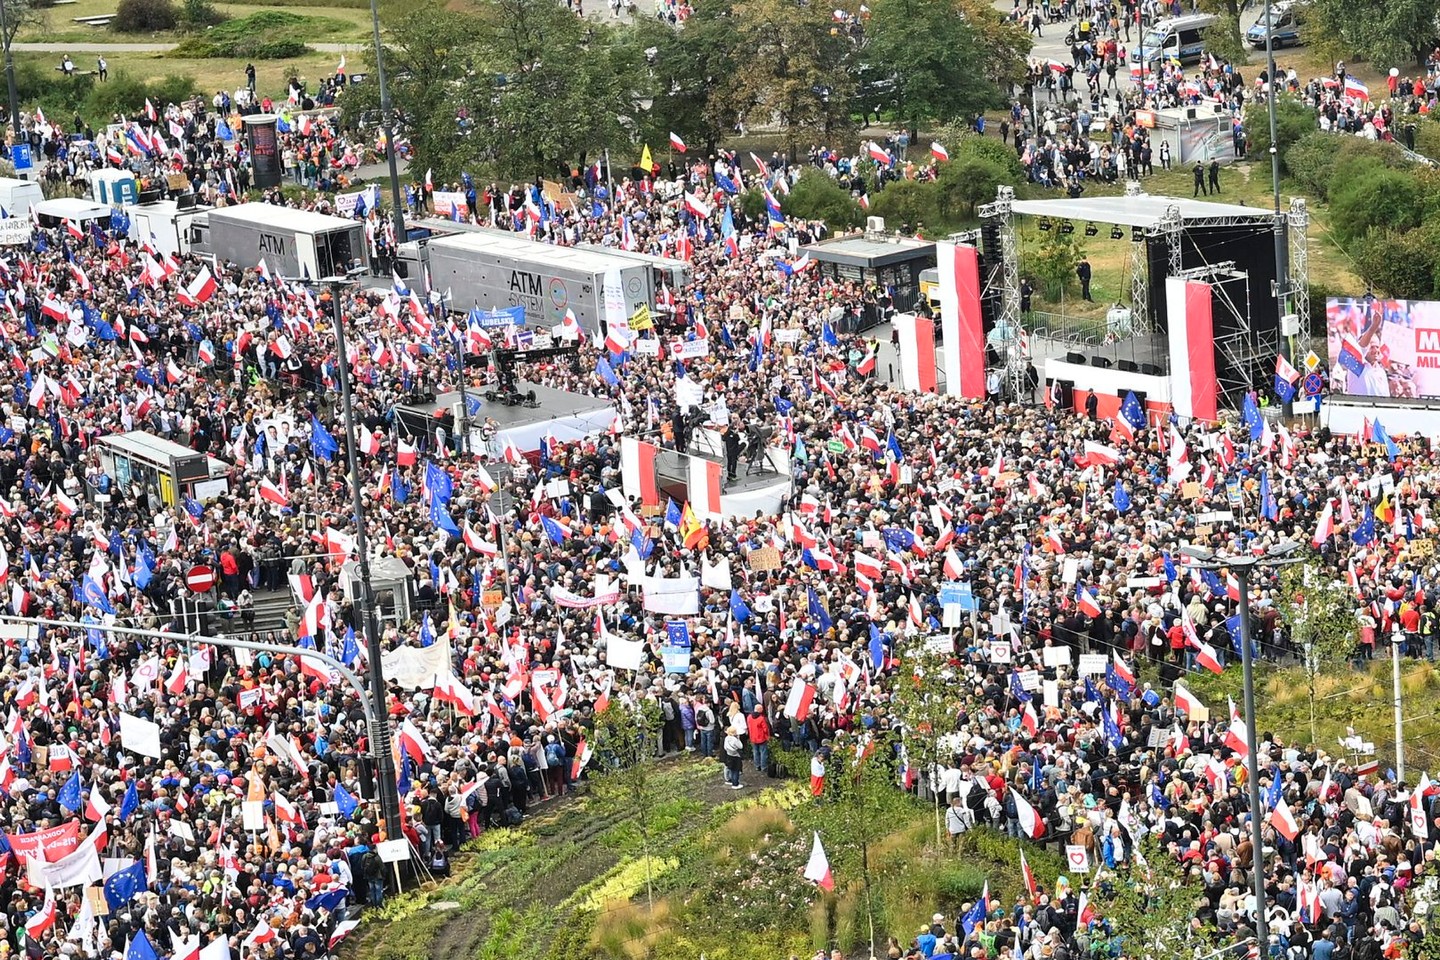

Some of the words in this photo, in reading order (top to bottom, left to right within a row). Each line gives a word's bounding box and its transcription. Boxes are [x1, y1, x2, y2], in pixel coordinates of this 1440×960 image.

[259, 233, 286, 256] ATM
[510, 270, 543, 297] ATM
[509, 292, 544, 313] SYSTEM
[481, 316, 514, 327] LUBELSKIE
